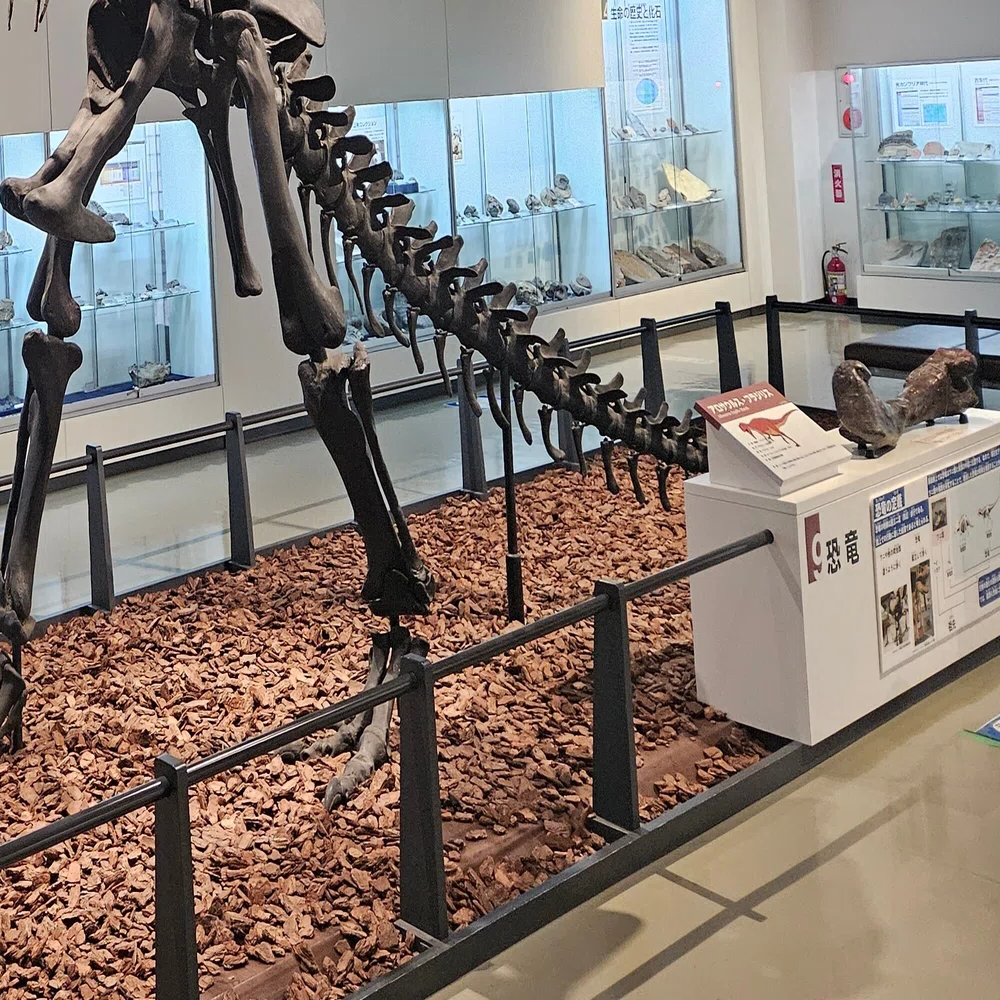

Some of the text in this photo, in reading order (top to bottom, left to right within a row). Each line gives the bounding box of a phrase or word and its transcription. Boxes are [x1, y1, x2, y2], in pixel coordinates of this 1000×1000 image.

[611, 6, 661, 20] 生命の歴史と化石
[833, 168, 842, 198] 消火器
[826, 529, 860, 575] 恐竜
